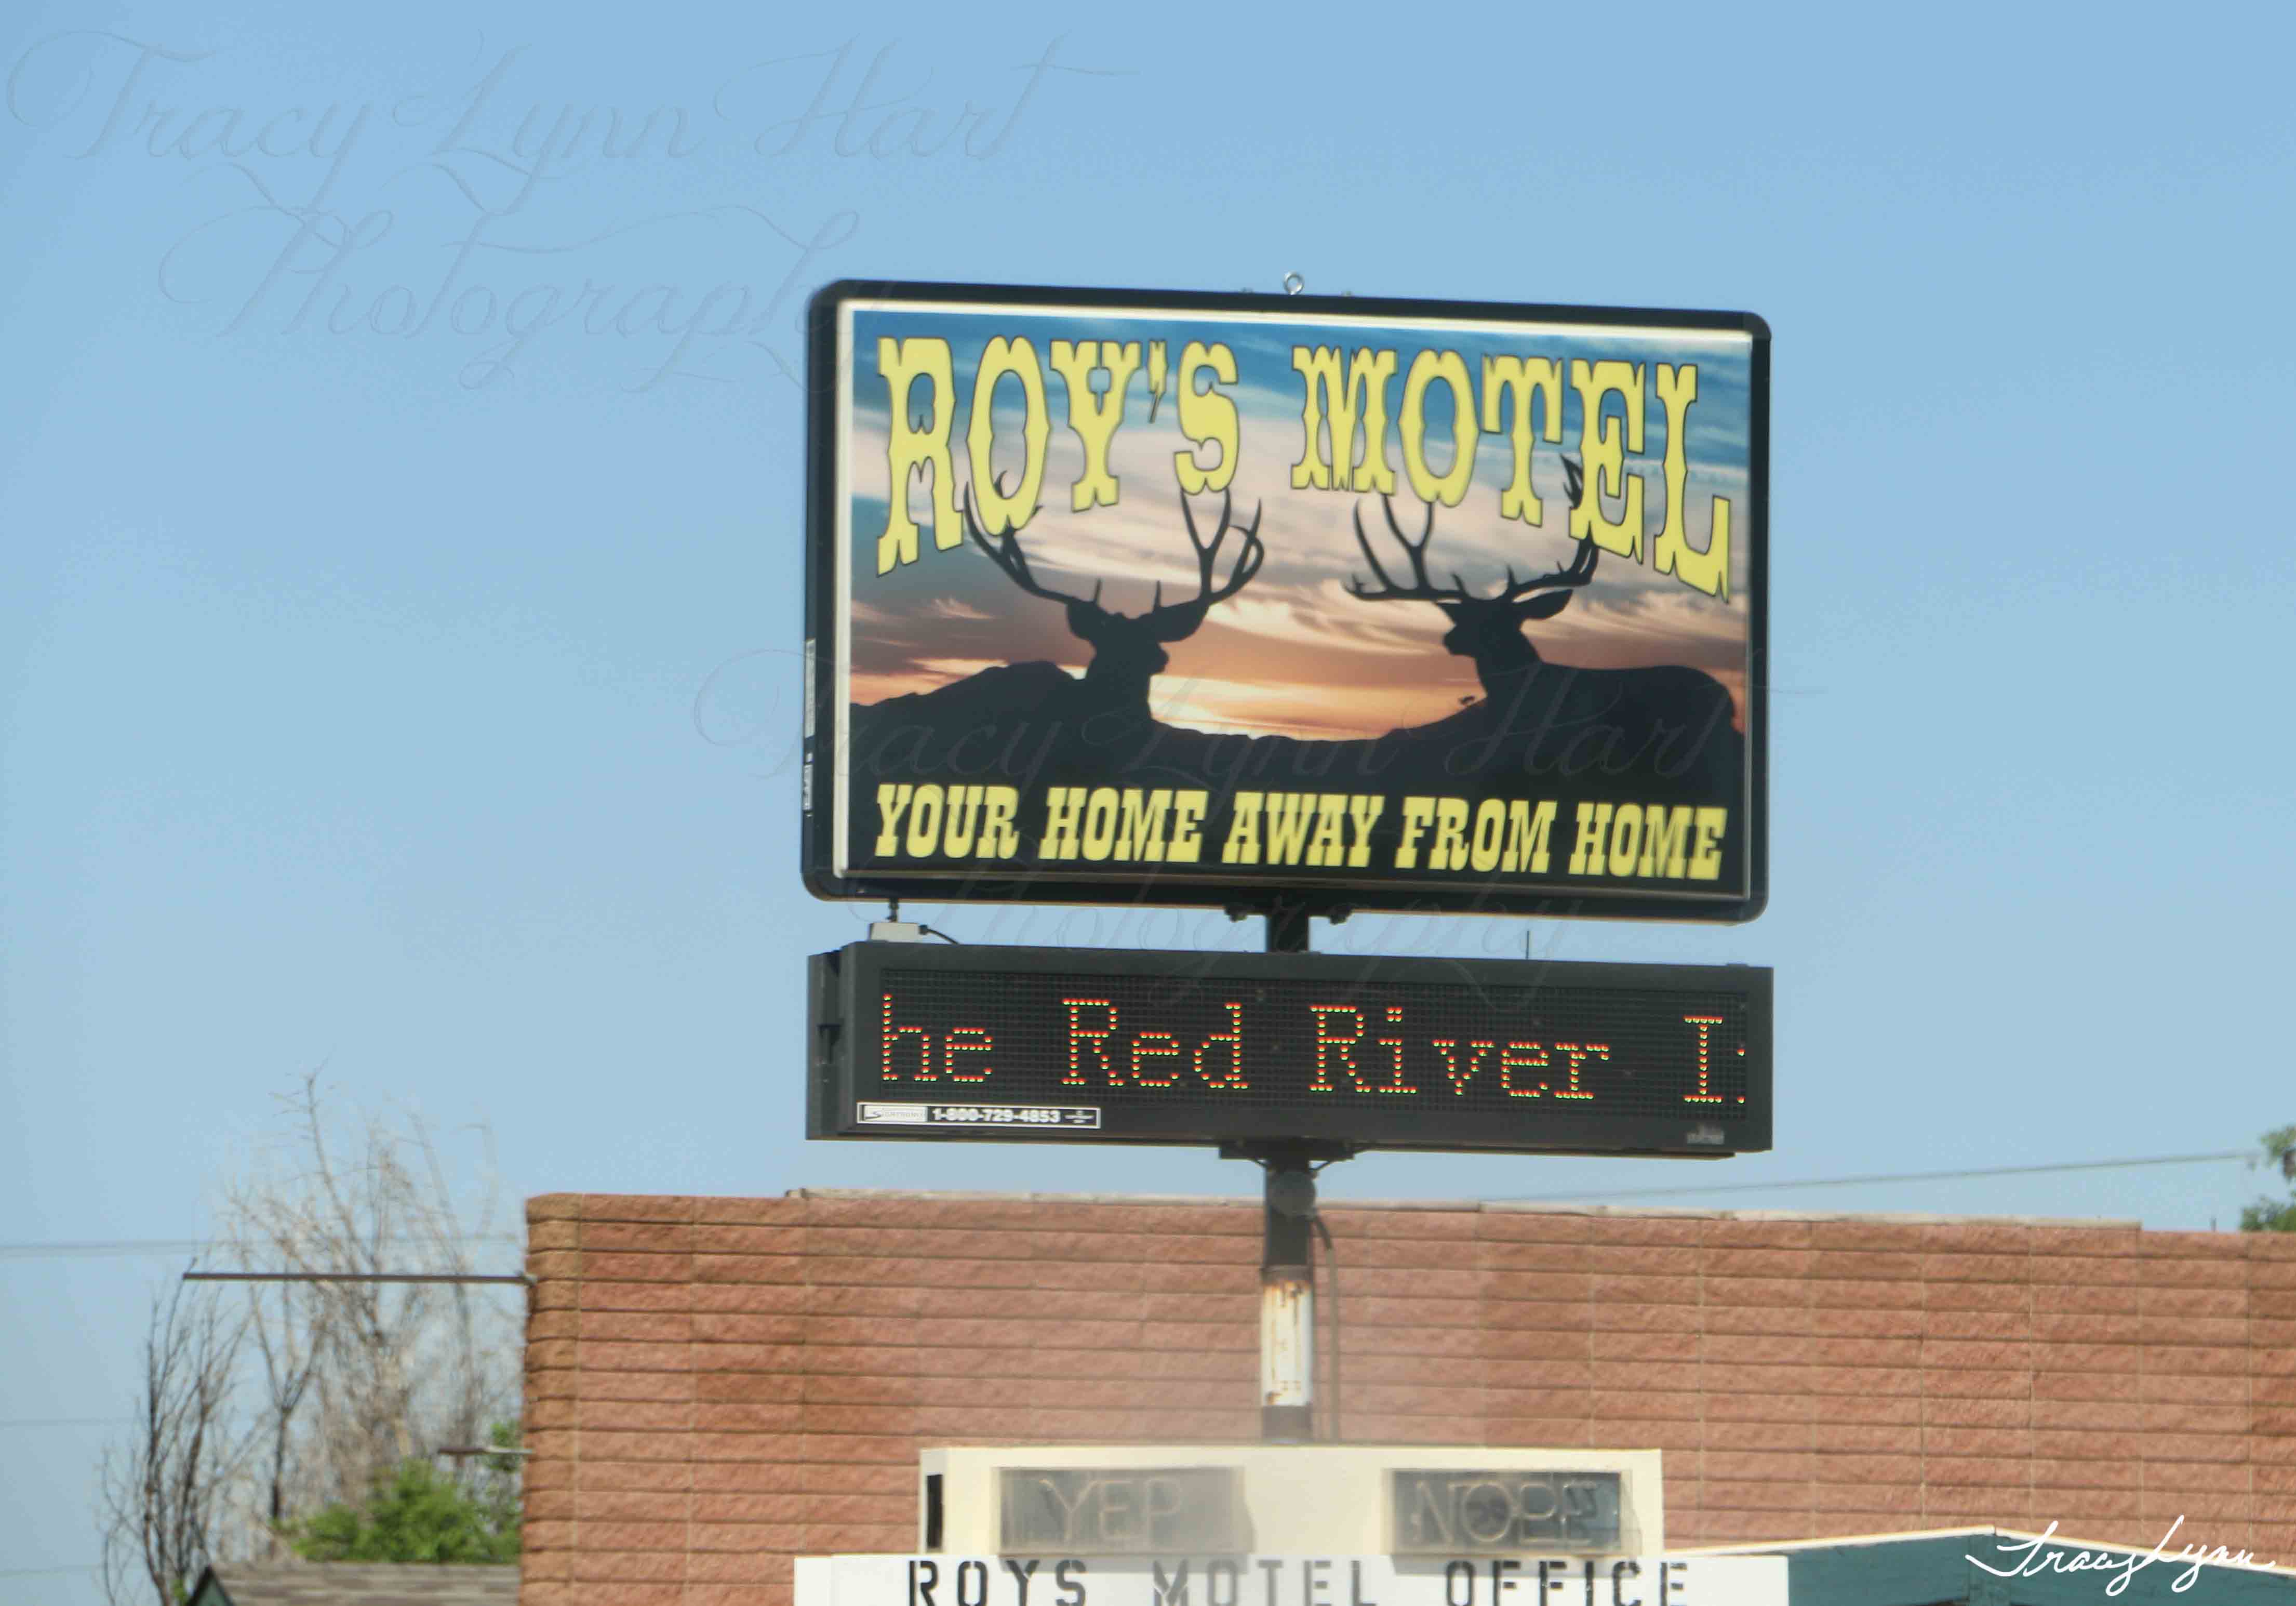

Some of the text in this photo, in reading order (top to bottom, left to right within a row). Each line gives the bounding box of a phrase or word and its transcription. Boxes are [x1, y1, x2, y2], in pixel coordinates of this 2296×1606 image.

[877, 335, 1730, 604] ROY'S MOTEL
[874, 783, 1019, 860] YOUR
[1038, 786, 1209, 863] HOME
[1221, 791, 1385, 868] AWAY
[1394, 795, 1558, 874] FROM
[1567, 801, 1728, 881] HOME
[883, 993, 993, 1082] he
[1062, 998, 1249, 1089] Red
[1310, 1005, 1610, 1098] River
[1039, 1478, 1183, 1543] YEP
[909, 1559, 1688, 1606] ROYS MOTEL OFFICE
